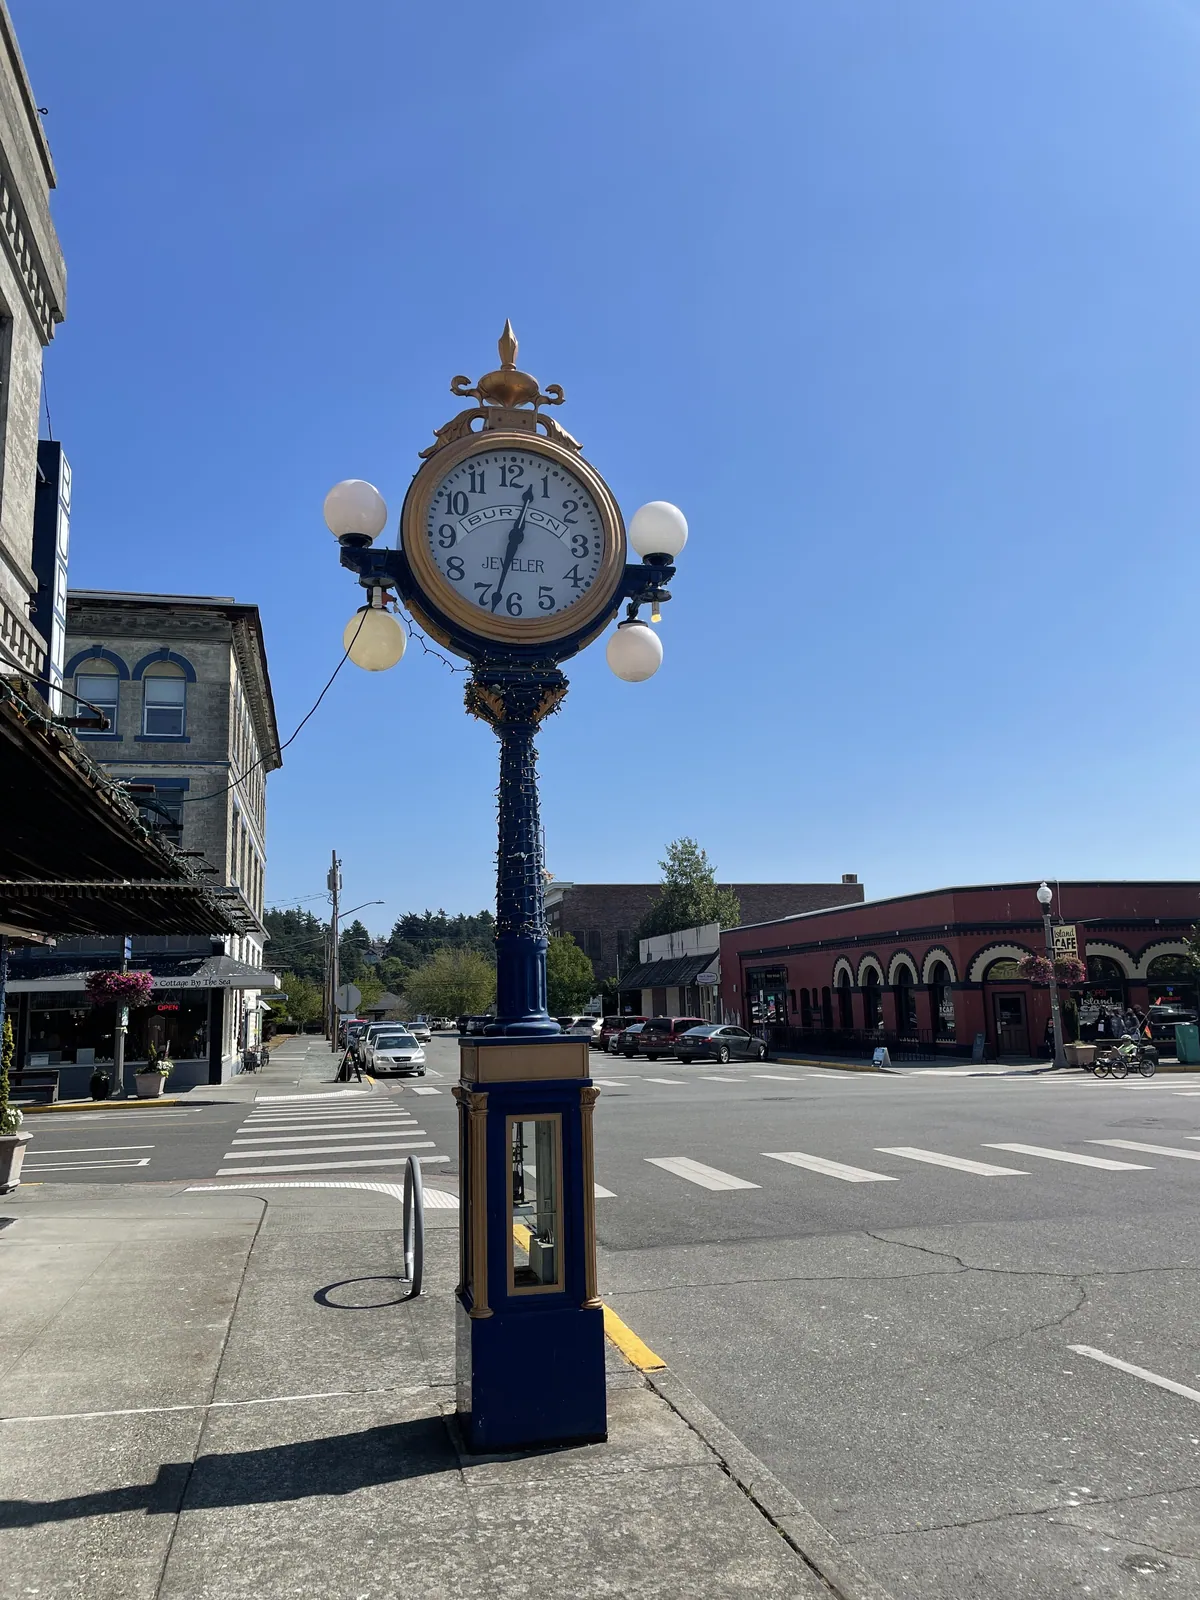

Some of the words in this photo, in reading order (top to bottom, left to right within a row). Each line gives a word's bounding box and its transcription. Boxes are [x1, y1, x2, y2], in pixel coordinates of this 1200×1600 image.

[468, 470, 486, 494] 11
[499, 463, 524, 488] 12
[541, 475, 550, 498] 1
[445, 491, 469, 516] 10
[562, 500, 578, 524] 2
[438, 524, 456, 549] 9
[571, 534, 589, 558] 3
[446, 556, 465, 581] 8
[562, 564, 584, 588] 4
[474, 582, 493, 606] 7
[506, 592, 523, 616] 6
[538, 586, 555, 610] 5
[1055, 938, 1076, 950] CAFE
[160, 980, 188, 988] Cottage
[191, 980, 201, 988] By
[203, 977, 217, 986] The
[1081, 996, 1114, 1005] Island
